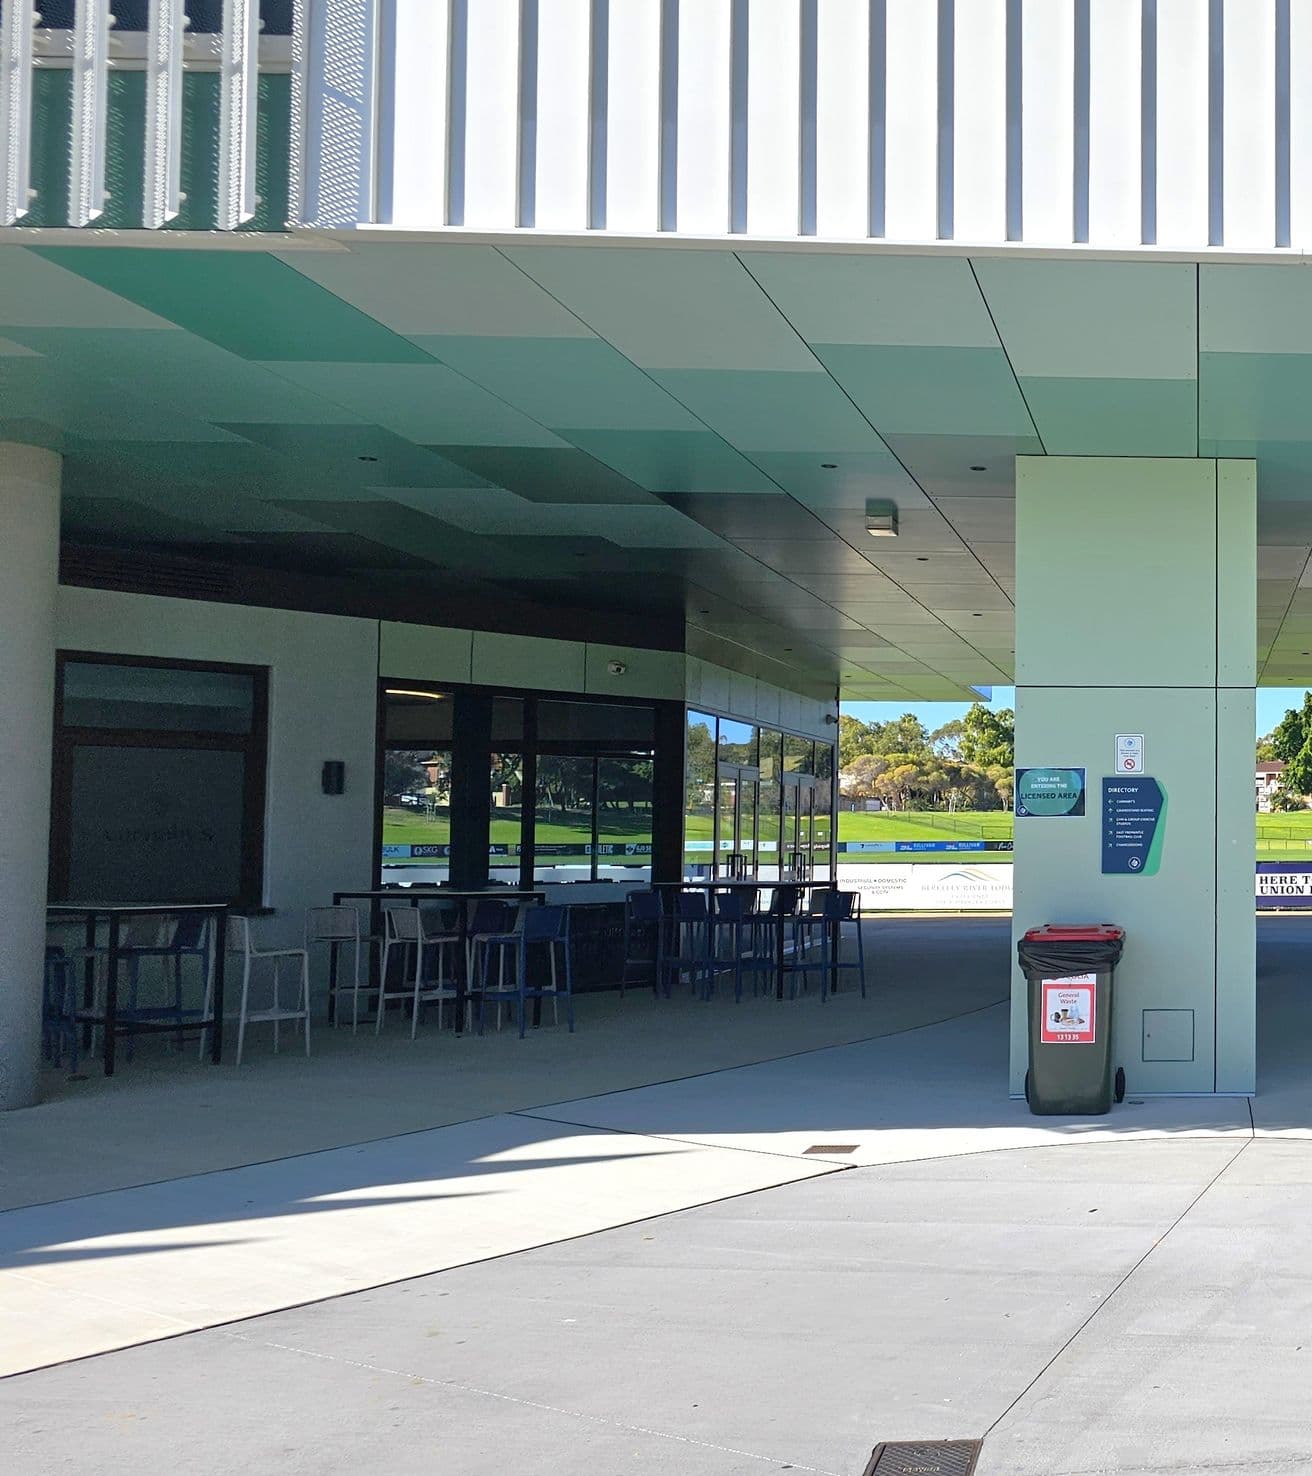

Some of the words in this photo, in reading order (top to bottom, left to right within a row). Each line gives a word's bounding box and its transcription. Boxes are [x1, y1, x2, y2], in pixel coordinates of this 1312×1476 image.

[1021, 792, 1056, 800] LICENSED
[1259, 875, 1298, 885] HERE
[1260, 885, 1305, 895] UNION
